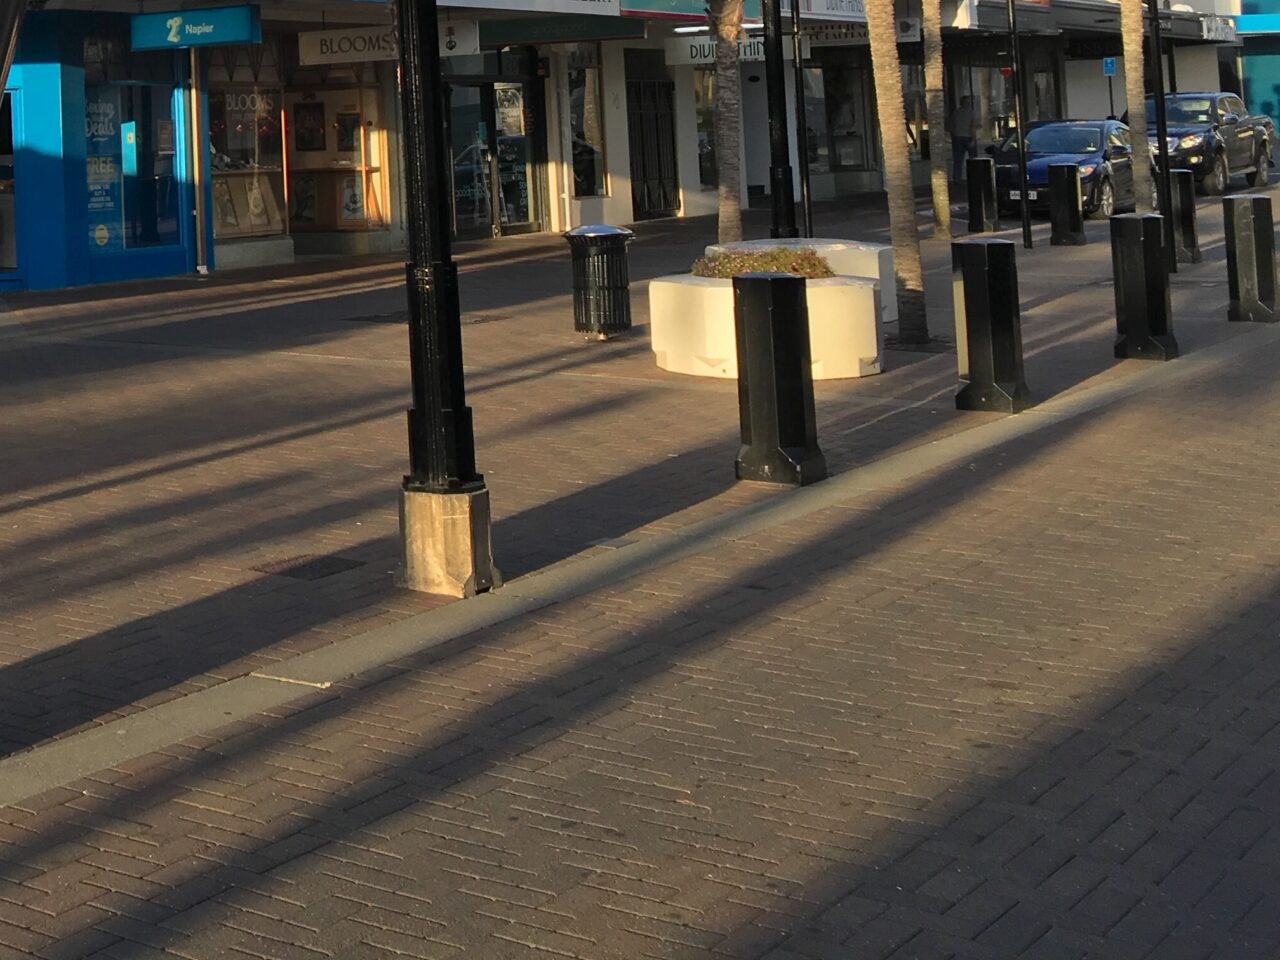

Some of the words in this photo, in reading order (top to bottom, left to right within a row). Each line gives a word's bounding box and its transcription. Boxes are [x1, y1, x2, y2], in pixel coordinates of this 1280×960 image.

[185, 23, 214, 36] Napier
[320, 34, 394, 55] BLOOMS
[690, 42, 718, 59] DIVI
[737, 41, 766, 57] THIN
[225, 93, 274, 111] BLOOMS
